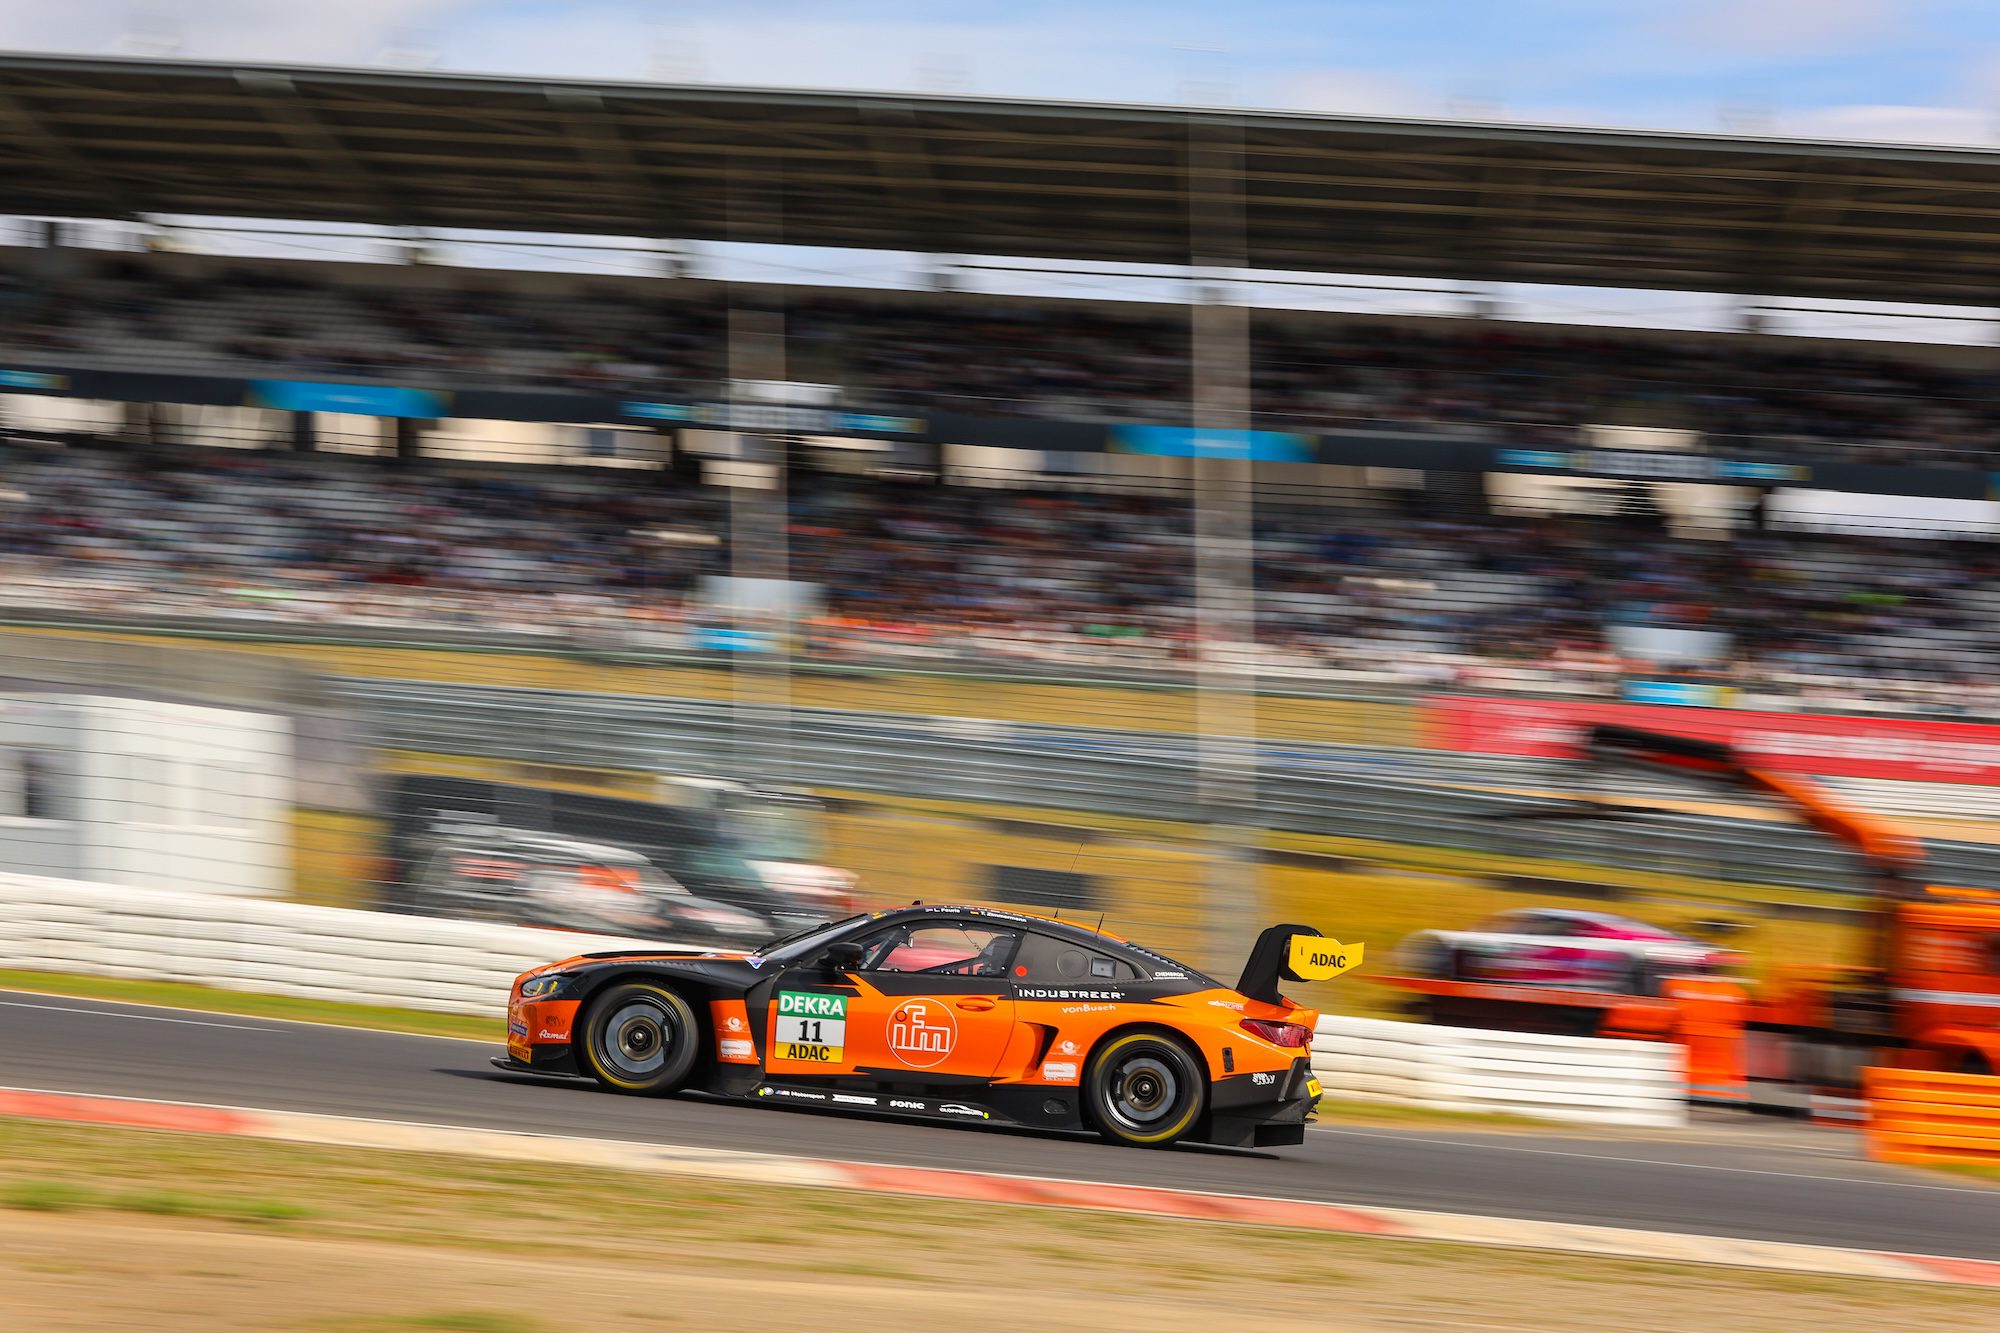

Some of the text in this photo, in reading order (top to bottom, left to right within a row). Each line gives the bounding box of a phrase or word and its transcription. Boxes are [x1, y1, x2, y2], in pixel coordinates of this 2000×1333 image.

[1309, 952, 1347, 969] ADAC
[1018, 988, 1123, 1000] INDUSTREER
[779, 993, 845, 1017] DEKRA
[1061, 1003, 1117, 1014] vonBusch
[798, 1020, 824, 1043] 11
[787, 1043, 830, 1062] ADAC
[791, 1090, 826, 1100] Motorsport
